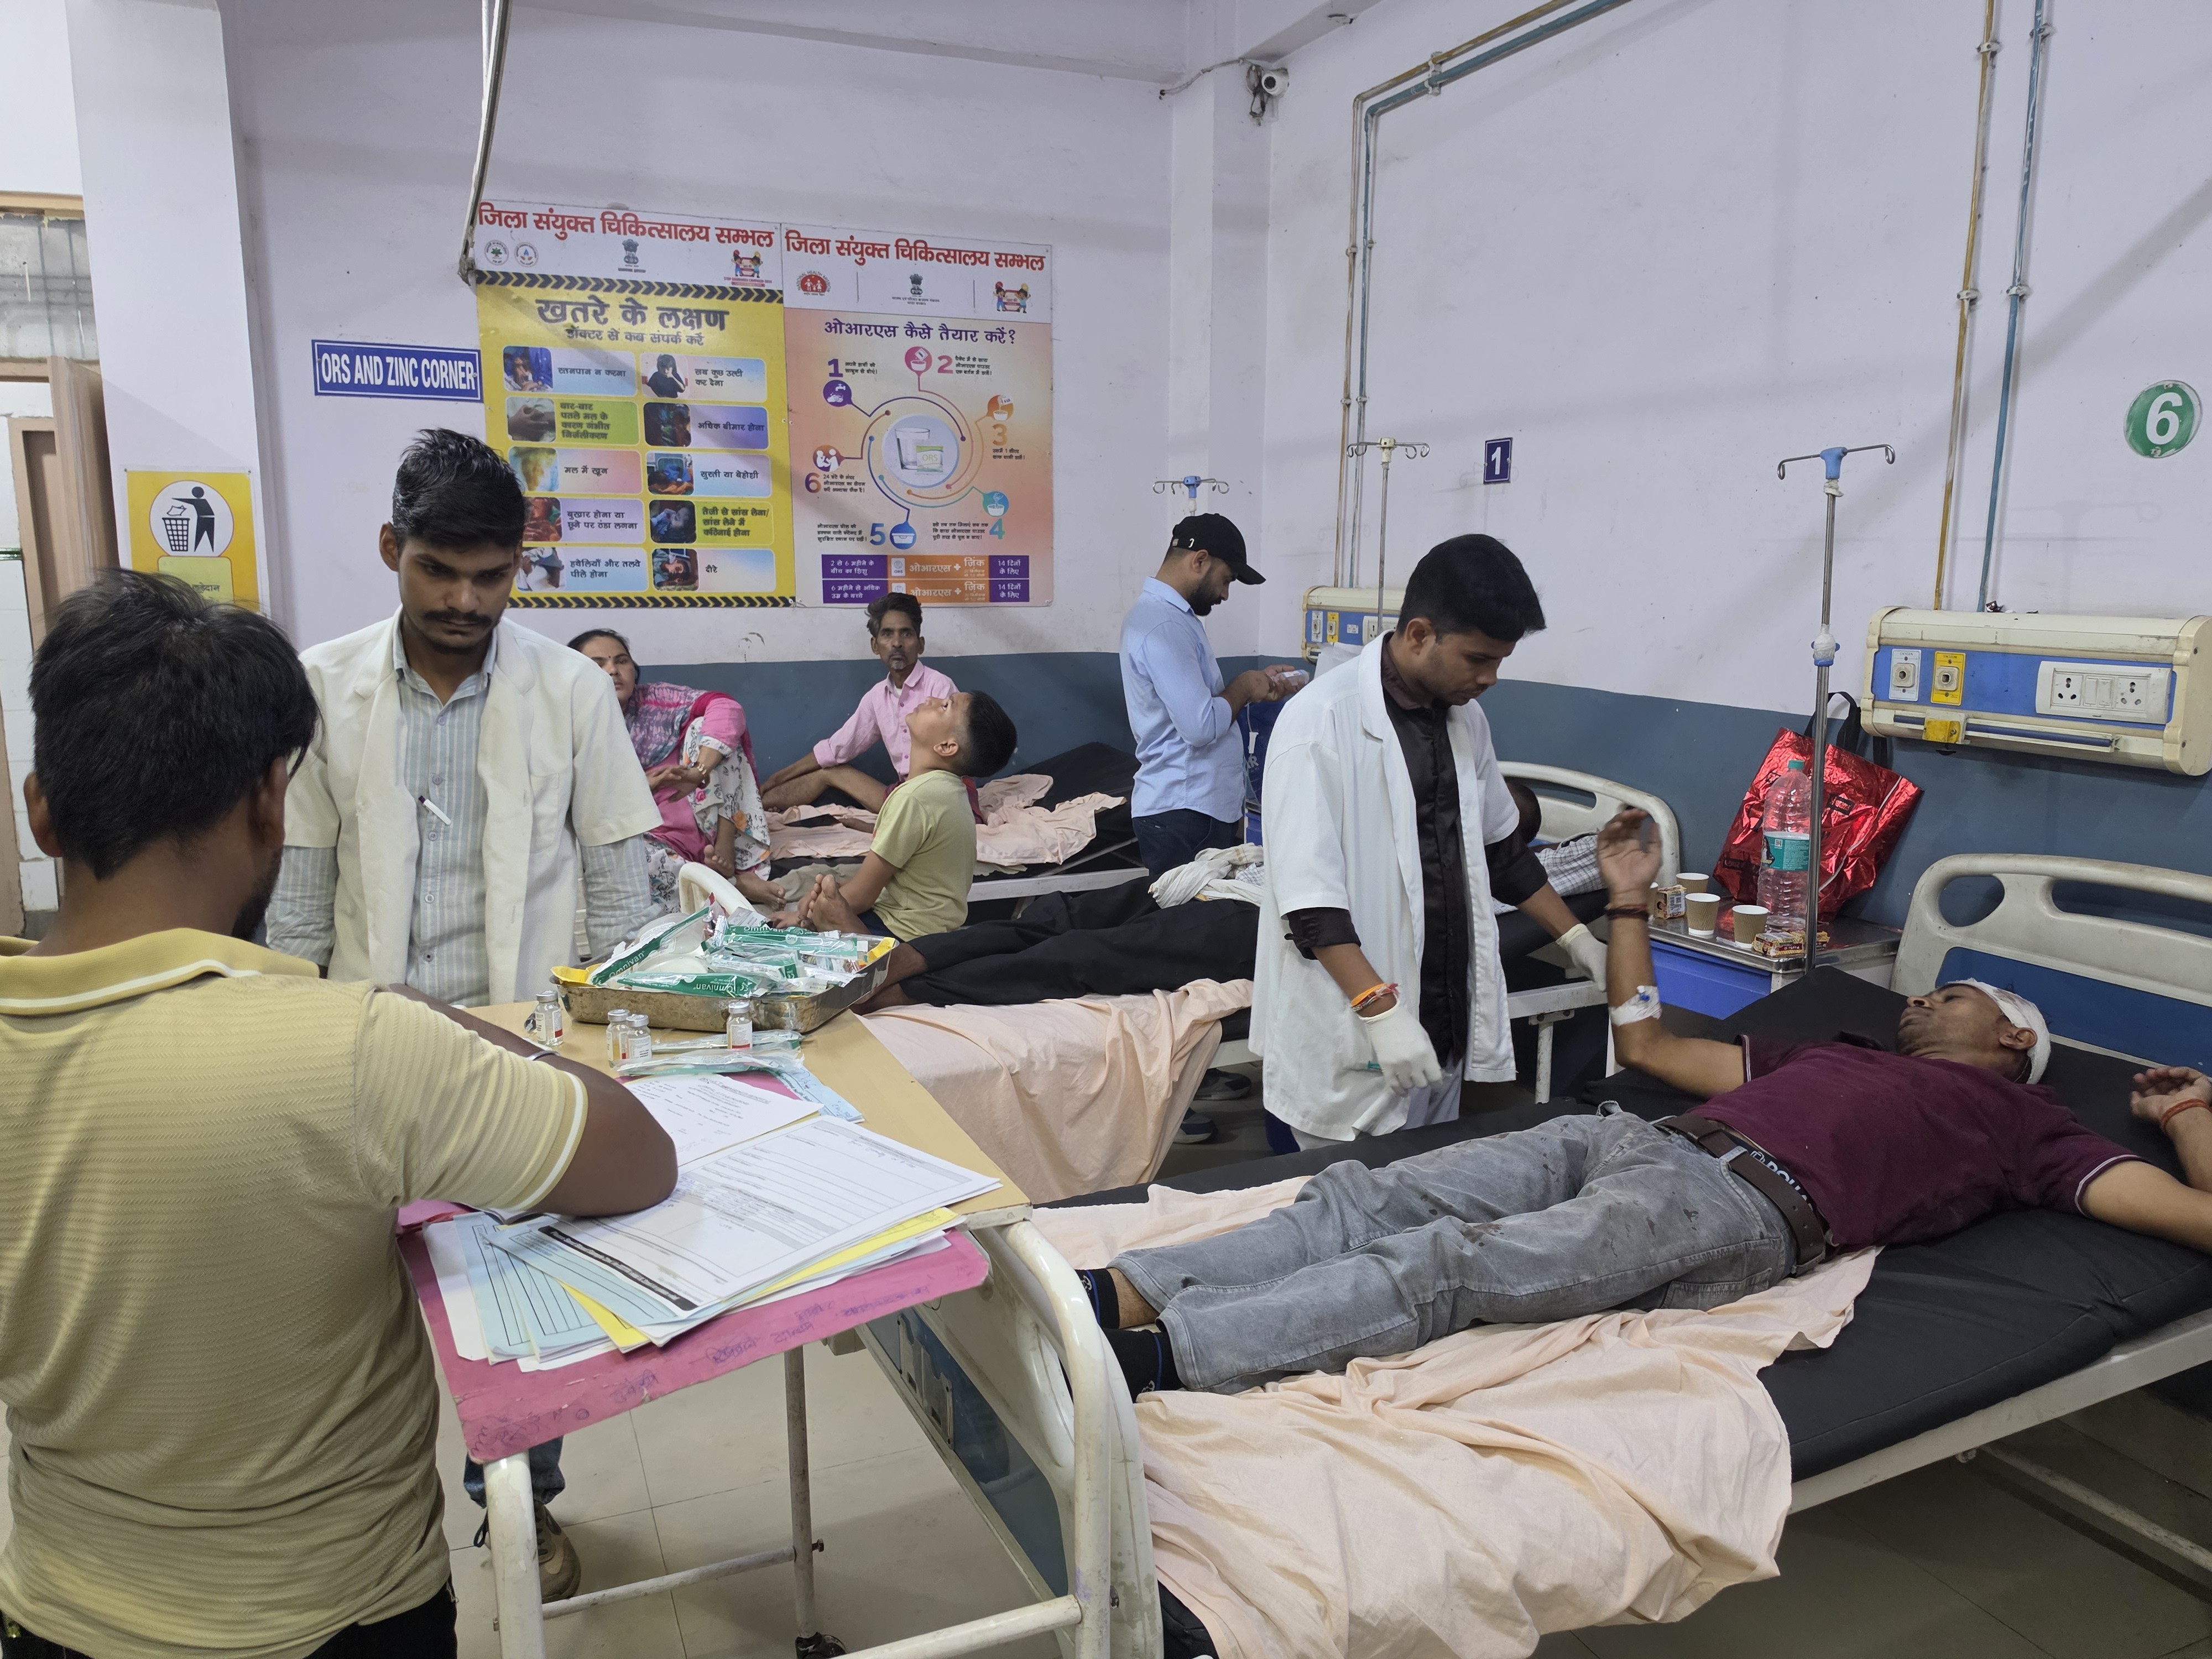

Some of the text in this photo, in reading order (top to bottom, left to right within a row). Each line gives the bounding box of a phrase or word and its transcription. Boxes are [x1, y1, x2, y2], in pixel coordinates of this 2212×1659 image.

[479, 202, 774, 248] जिला संयुक्त चिकित्सालय सम्भल
[785, 229, 1046, 272] जिला संयुक्त चिकित्सालय सम्भल
[536, 295, 729, 331] खतरे के लक्षण
[608, 328, 619, 341] से
[624, 333, 644, 342] कब
[686, 332, 705, 346] करें
[824, 319, 899, 338] ओआरएस
[904, 322, 933, 340] कैसे
[938, 324, 979, 342] तैयार
[321, 353, 476, 390] ORS AND ZINC CORNER
[558, 367, 592, 375] स्तनपान
[695, 368, 707, 376] सब
[827, 358, 843, 378] 1
[937, 355, 953, 374] 2
[695, 378, 724, 387] कर देना
[2146, 392, 2182, 445] 6
[992, 423, 1008, 446] 3
[922, 453, 938, 462] ORS
[1491, 447, 1501, 475] 1
[581, 465, 589, 475] में
[592, 467, 608, 477] खून
[805, 472, 821, 493] 6
[567, 510, 625, 520] बुखार होना या
[614, 522, 638, 530] लगना
[870, 523, 886, 546] 5
[989, 518, 1005, 540] 4
[604, 559, 619, 568] और
[910, 562, 952, 572] ओआरएस
[571, 570, 607, 579] पीले होना
[910, 587, 952, 597] ओआरएस
[609, 951, 644, 978] Omnivan
[696, 983, 733, 993] Omnivan
